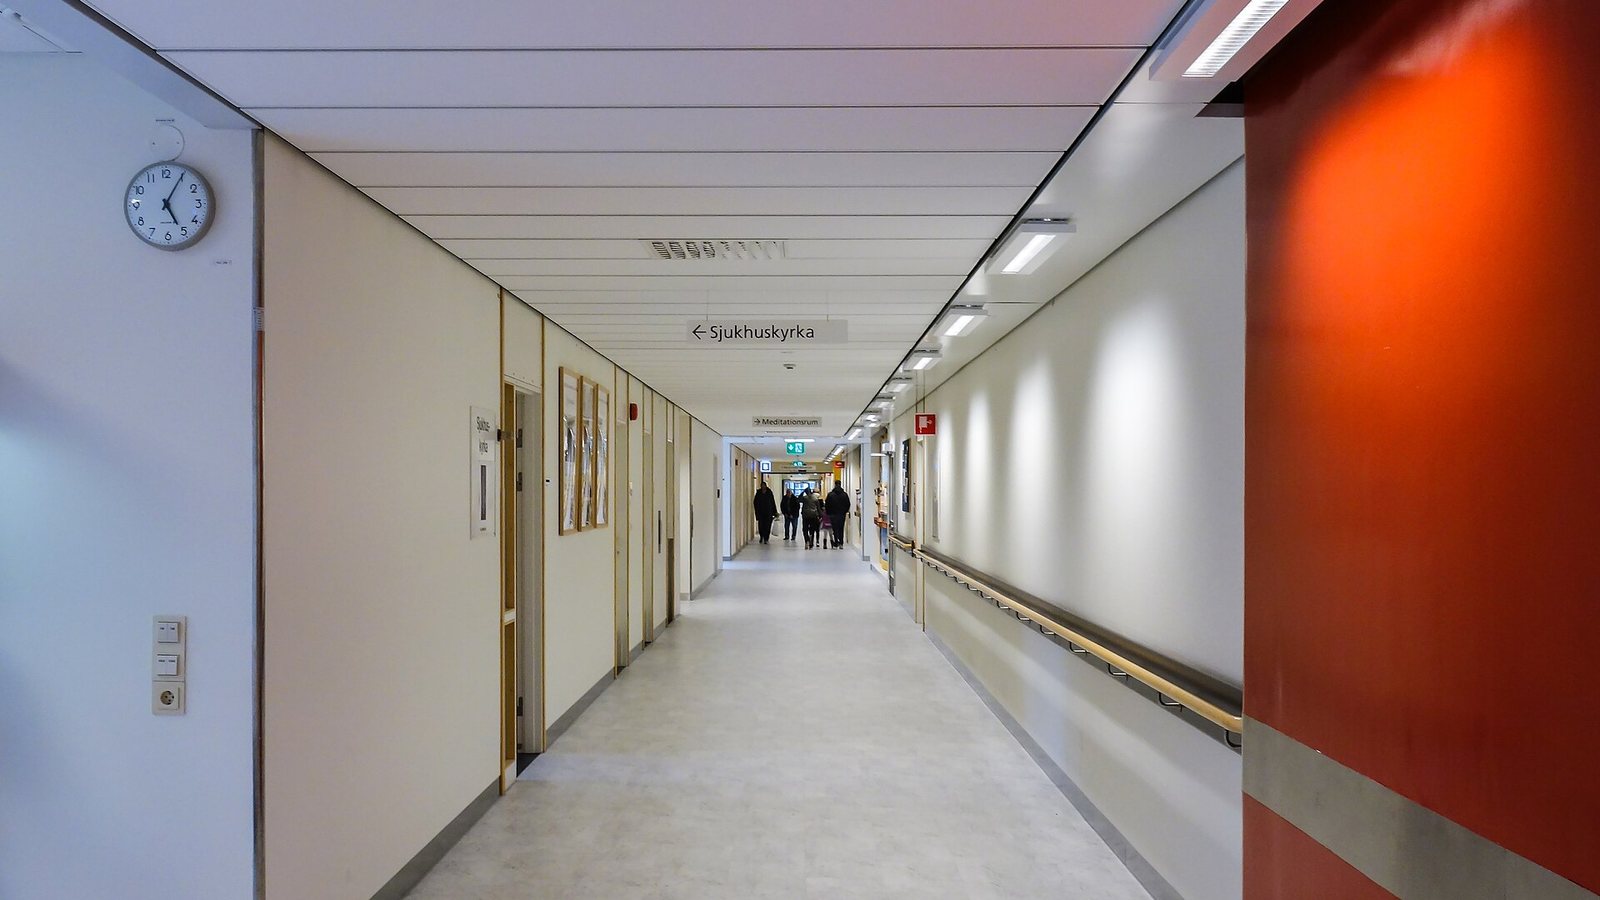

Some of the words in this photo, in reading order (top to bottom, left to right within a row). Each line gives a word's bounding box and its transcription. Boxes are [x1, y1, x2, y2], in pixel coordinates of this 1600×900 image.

[147, 172, 155, 183] 11
[161, 169, 171, 179] 12
[135, 185, 145, 195] 10
[189, 183, 198, 193] 2
[132, 201, 140, 211] 9
[195, 199, 203, 209] 3
[137, 217, 145, 226] 8
[191, 215, 199, 224] 4
[149, 227, 156, 237] 7
[164, 231, 172, 241] 6
[180, 226, 188, 236] 5
[710, 324, 815, 342] Sjukhuskyrka
[762, 418, 819, 426] Meditationsrum
